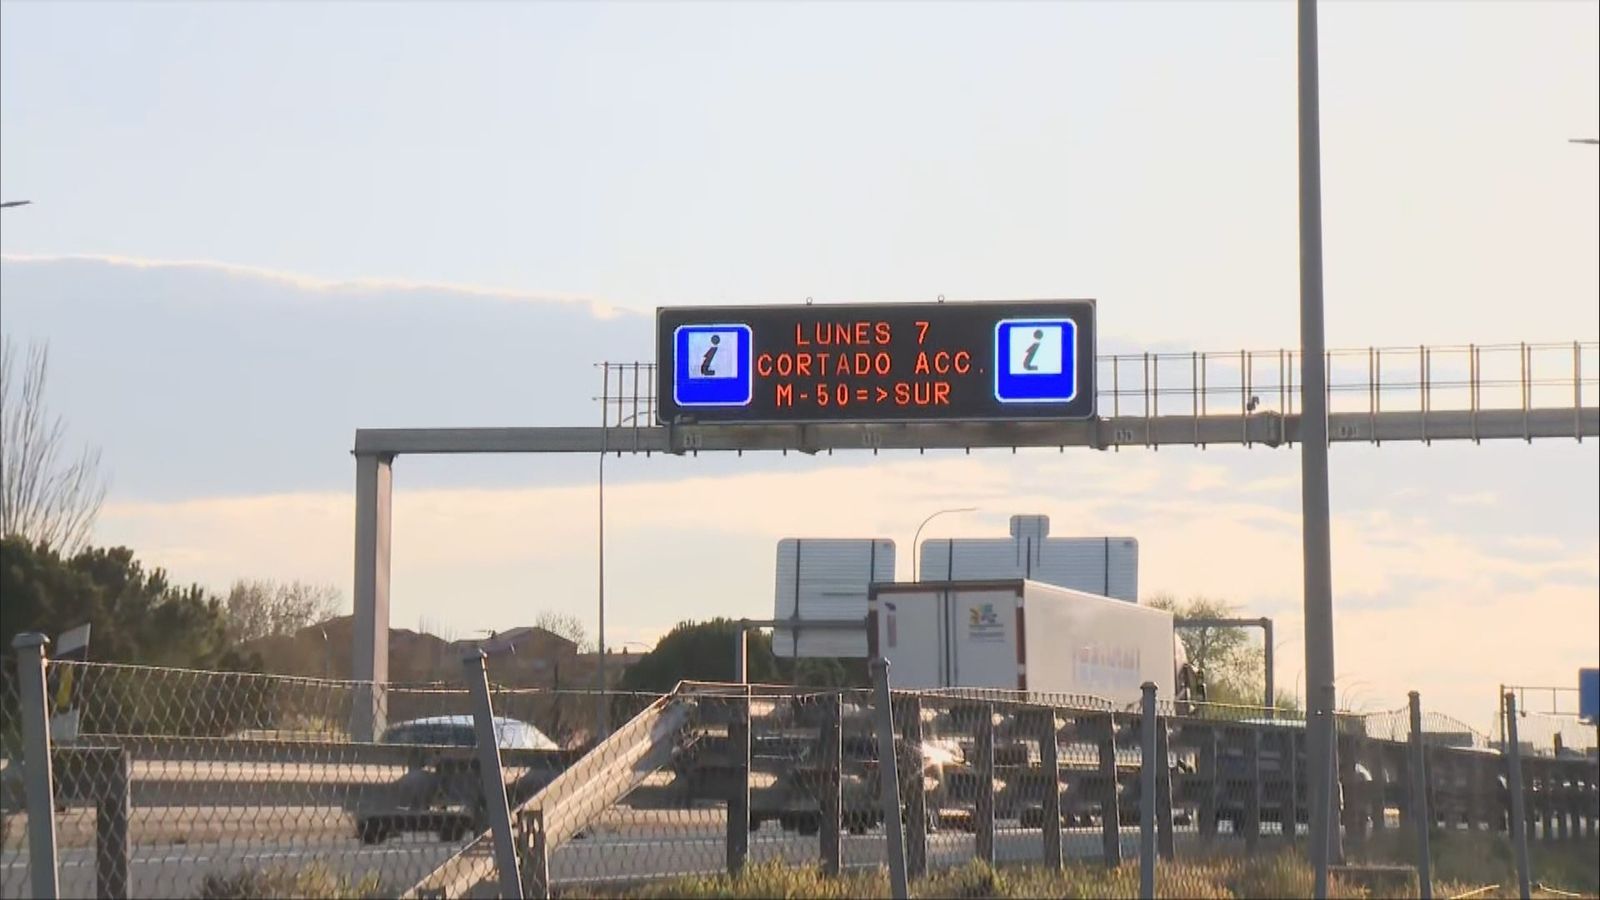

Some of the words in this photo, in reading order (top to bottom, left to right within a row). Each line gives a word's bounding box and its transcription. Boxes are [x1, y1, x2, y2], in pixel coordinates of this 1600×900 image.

[795, 321, 892, 348] LUNES
[915, 319, 930, 345] 7
[756, 350, 892, 378] CORTADO
